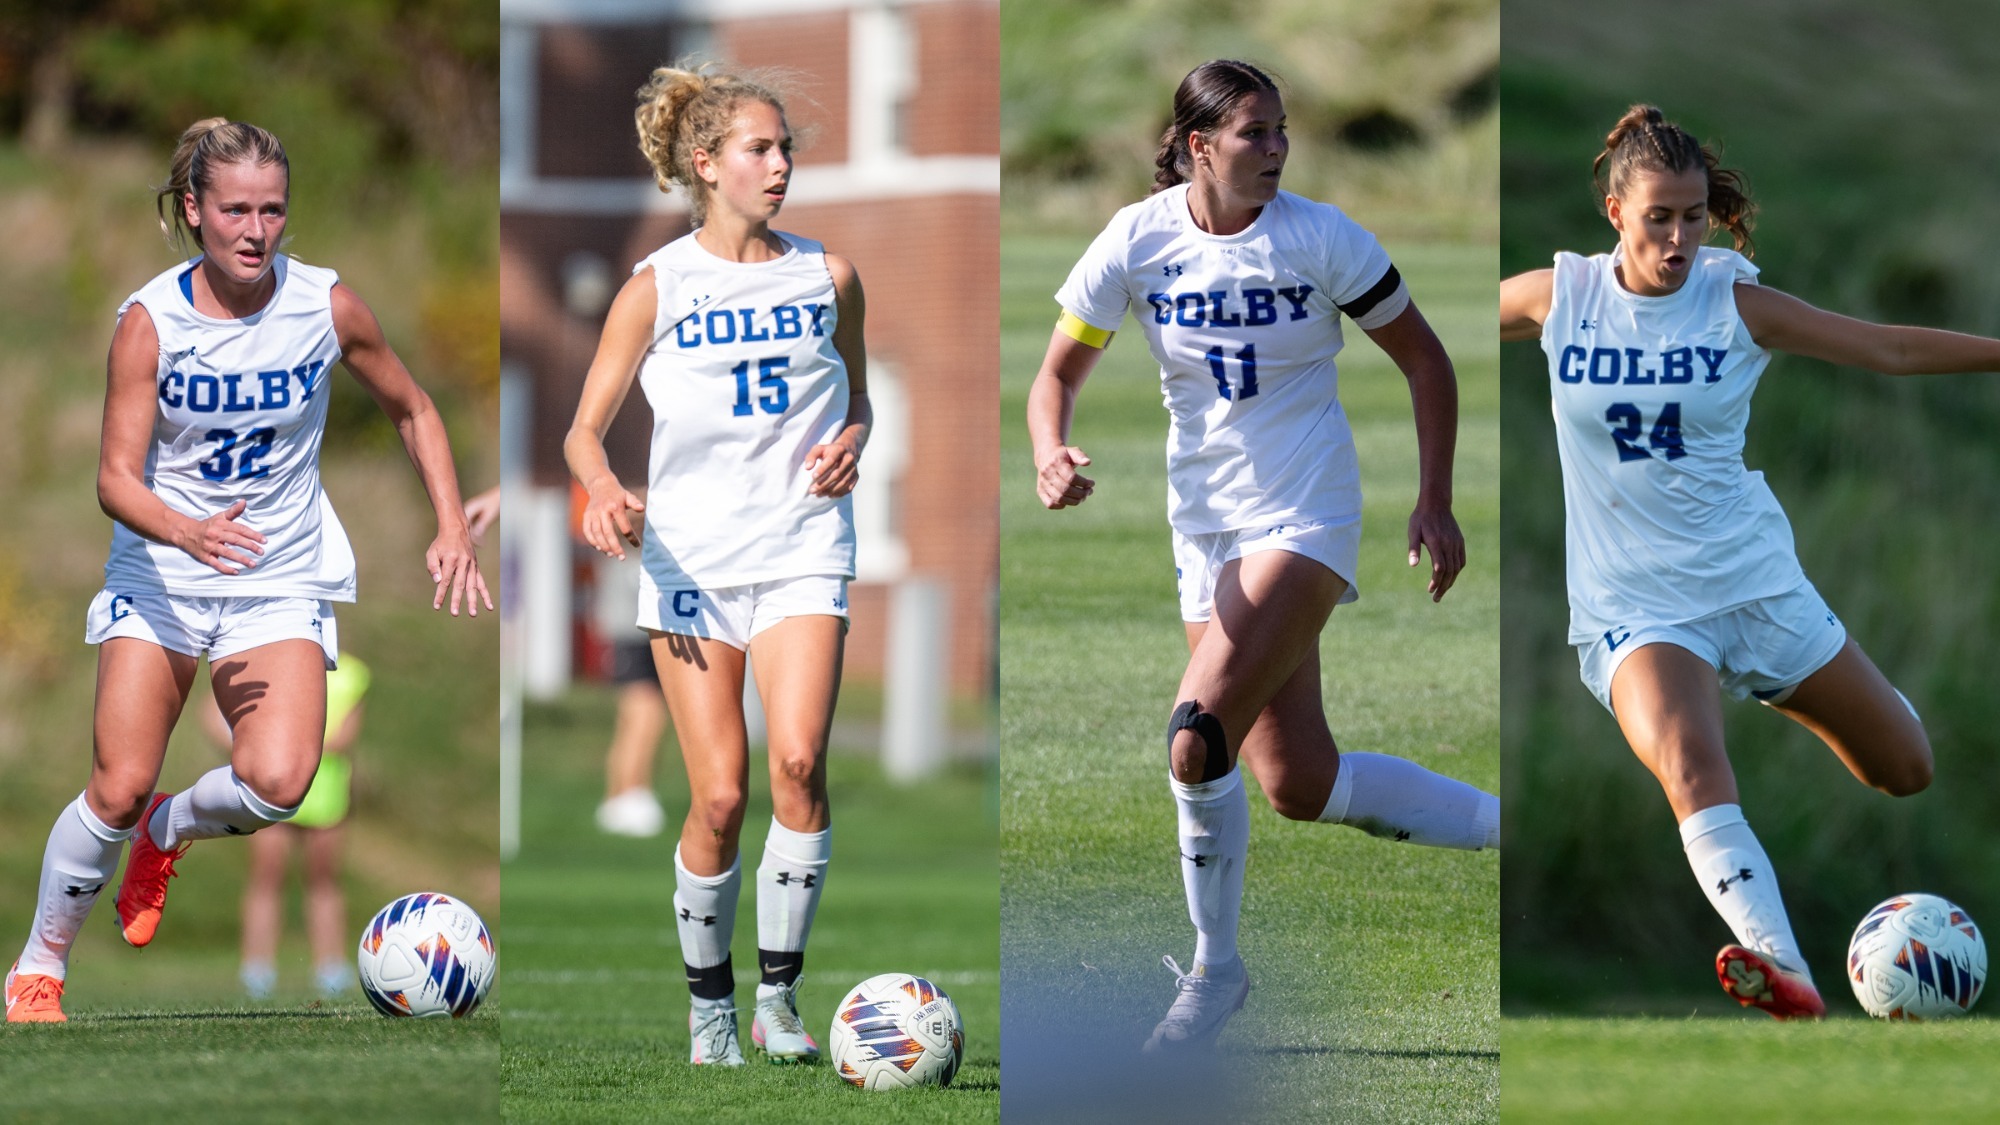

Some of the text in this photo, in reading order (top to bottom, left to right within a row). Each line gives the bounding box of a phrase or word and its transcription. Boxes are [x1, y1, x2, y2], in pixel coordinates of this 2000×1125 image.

[676, 303, 827, 348] COLBY
[1147, 286, 1314, 328] COLBY
[159, 360, 324, 413] COLBY
[731, 356, 790, 417] 15
[1205, 343, 1259, 401] 11
[1559, 345, 1728, 385] COLBY
[200, 426, 277, 482] 32
[1605, 402, 1688, 463] 24
[110, 595, 133, 622] C
[672, 590, 699, 618] C
